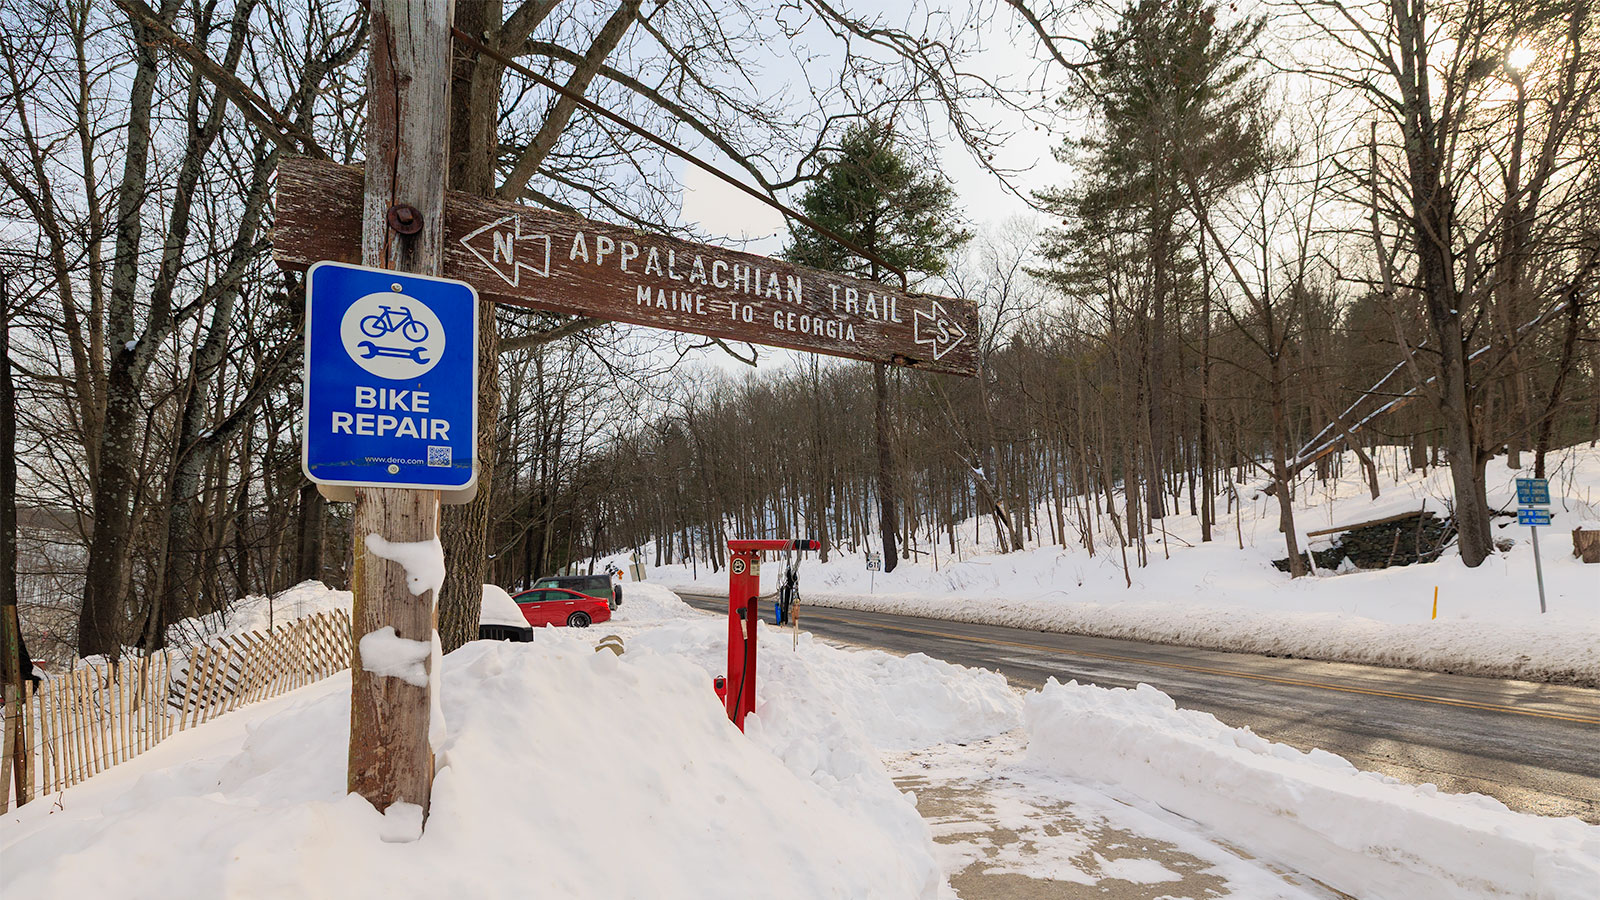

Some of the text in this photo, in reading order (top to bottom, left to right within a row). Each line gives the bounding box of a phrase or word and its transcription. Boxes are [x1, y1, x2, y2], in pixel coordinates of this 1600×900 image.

[493, 230, 514, 265] N
[569, 231, 903, 324] APPALACHIAN TRAIL
[637, 284, 856, 342] MAINE TO GEORGIA
[936, 318, 950, 345] S
[355, 385, 430, 413] BIKE
[331, 411, 450, 441] REPAIR
[365, 456, 424, 465] www.dero.com
